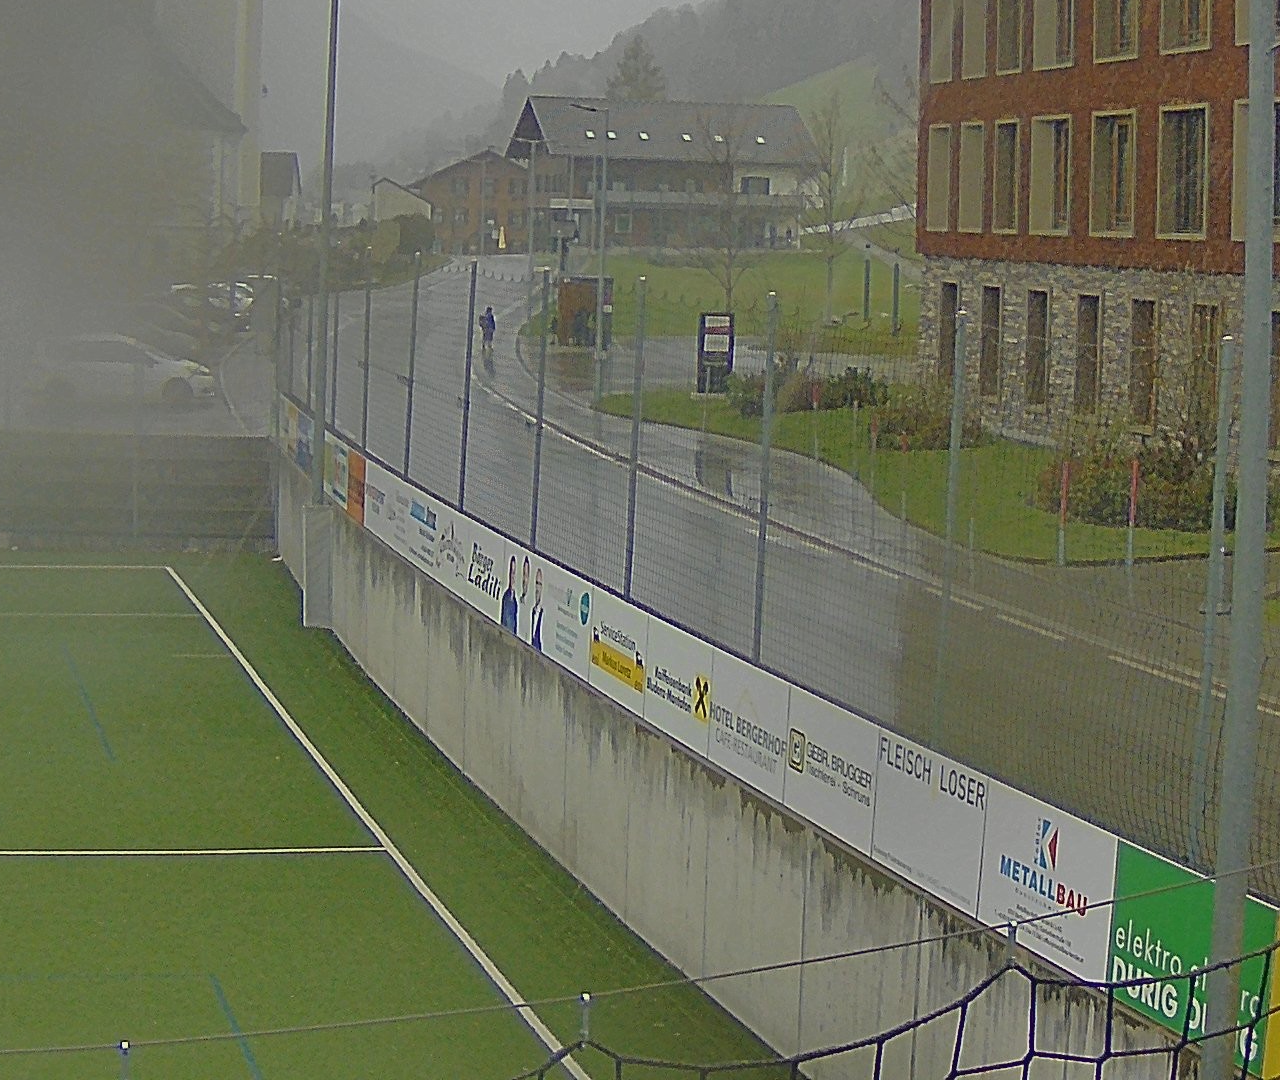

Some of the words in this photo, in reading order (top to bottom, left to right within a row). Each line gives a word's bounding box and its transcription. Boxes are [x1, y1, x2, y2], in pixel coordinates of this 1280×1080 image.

[709, 701, 735, 731] HOTEL
[736, 716, 787, 759] BERGERHOF
[831, 754, 872, 791] BRUGGER
[879, 736, 932, 785] FLEISCH
[939, 765, 986, 811] LOSER
[1000, 854, 1088, 917] METALLBAU
[1115, 919, 1182, 976] elektro
